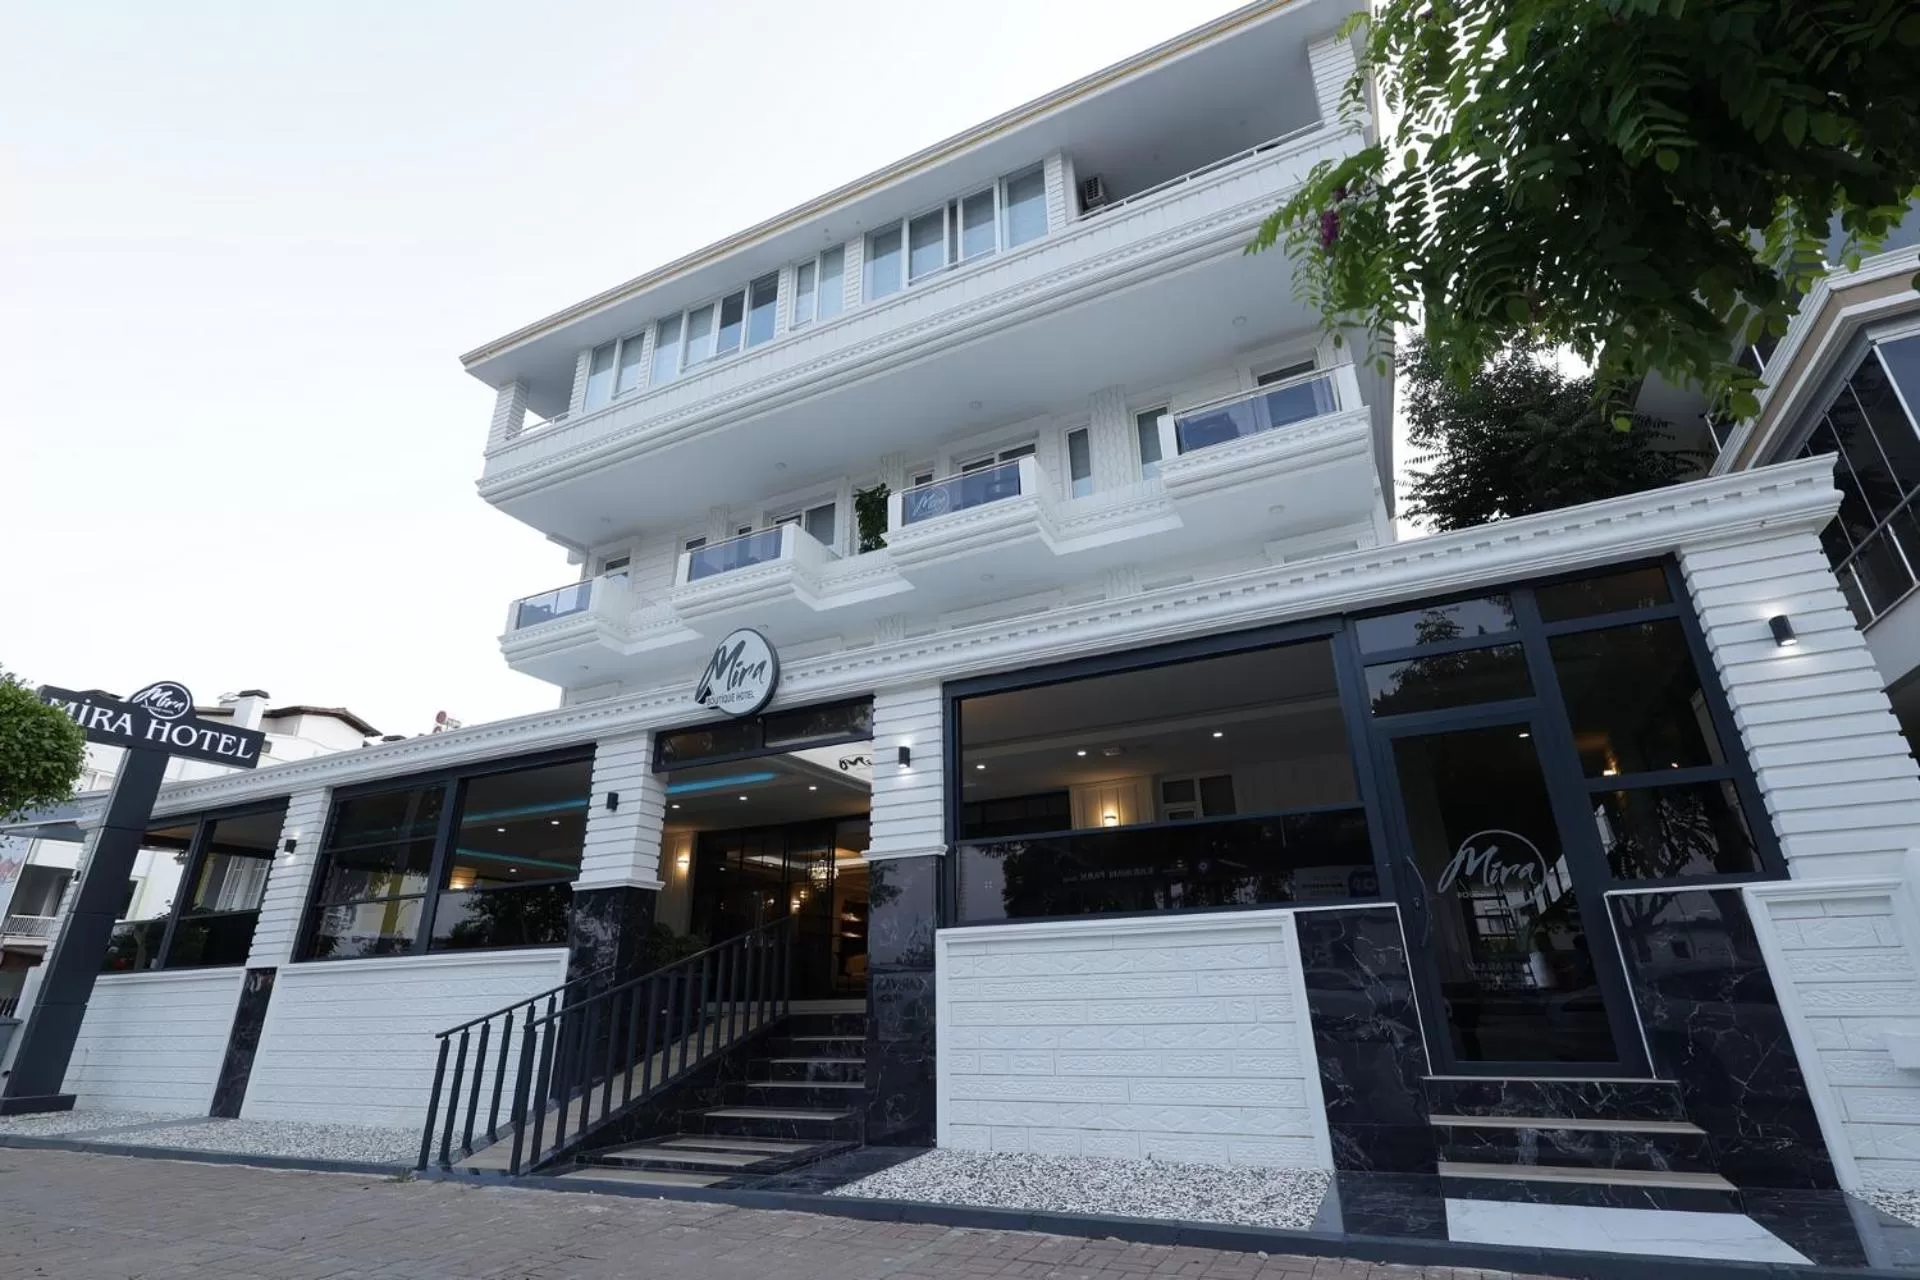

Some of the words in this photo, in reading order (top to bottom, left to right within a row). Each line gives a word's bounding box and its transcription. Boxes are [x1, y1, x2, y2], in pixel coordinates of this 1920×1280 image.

[694, 640, 768, 704] Mira
[131, 686, 186, 713] Mira
[707, 692, 735, 705] BOUTIQUE
[735, 690, 755, 701] HOTEL
[145, 717, 255, 759] HOTEL
[1437, 845, 1537, 893] Mira
